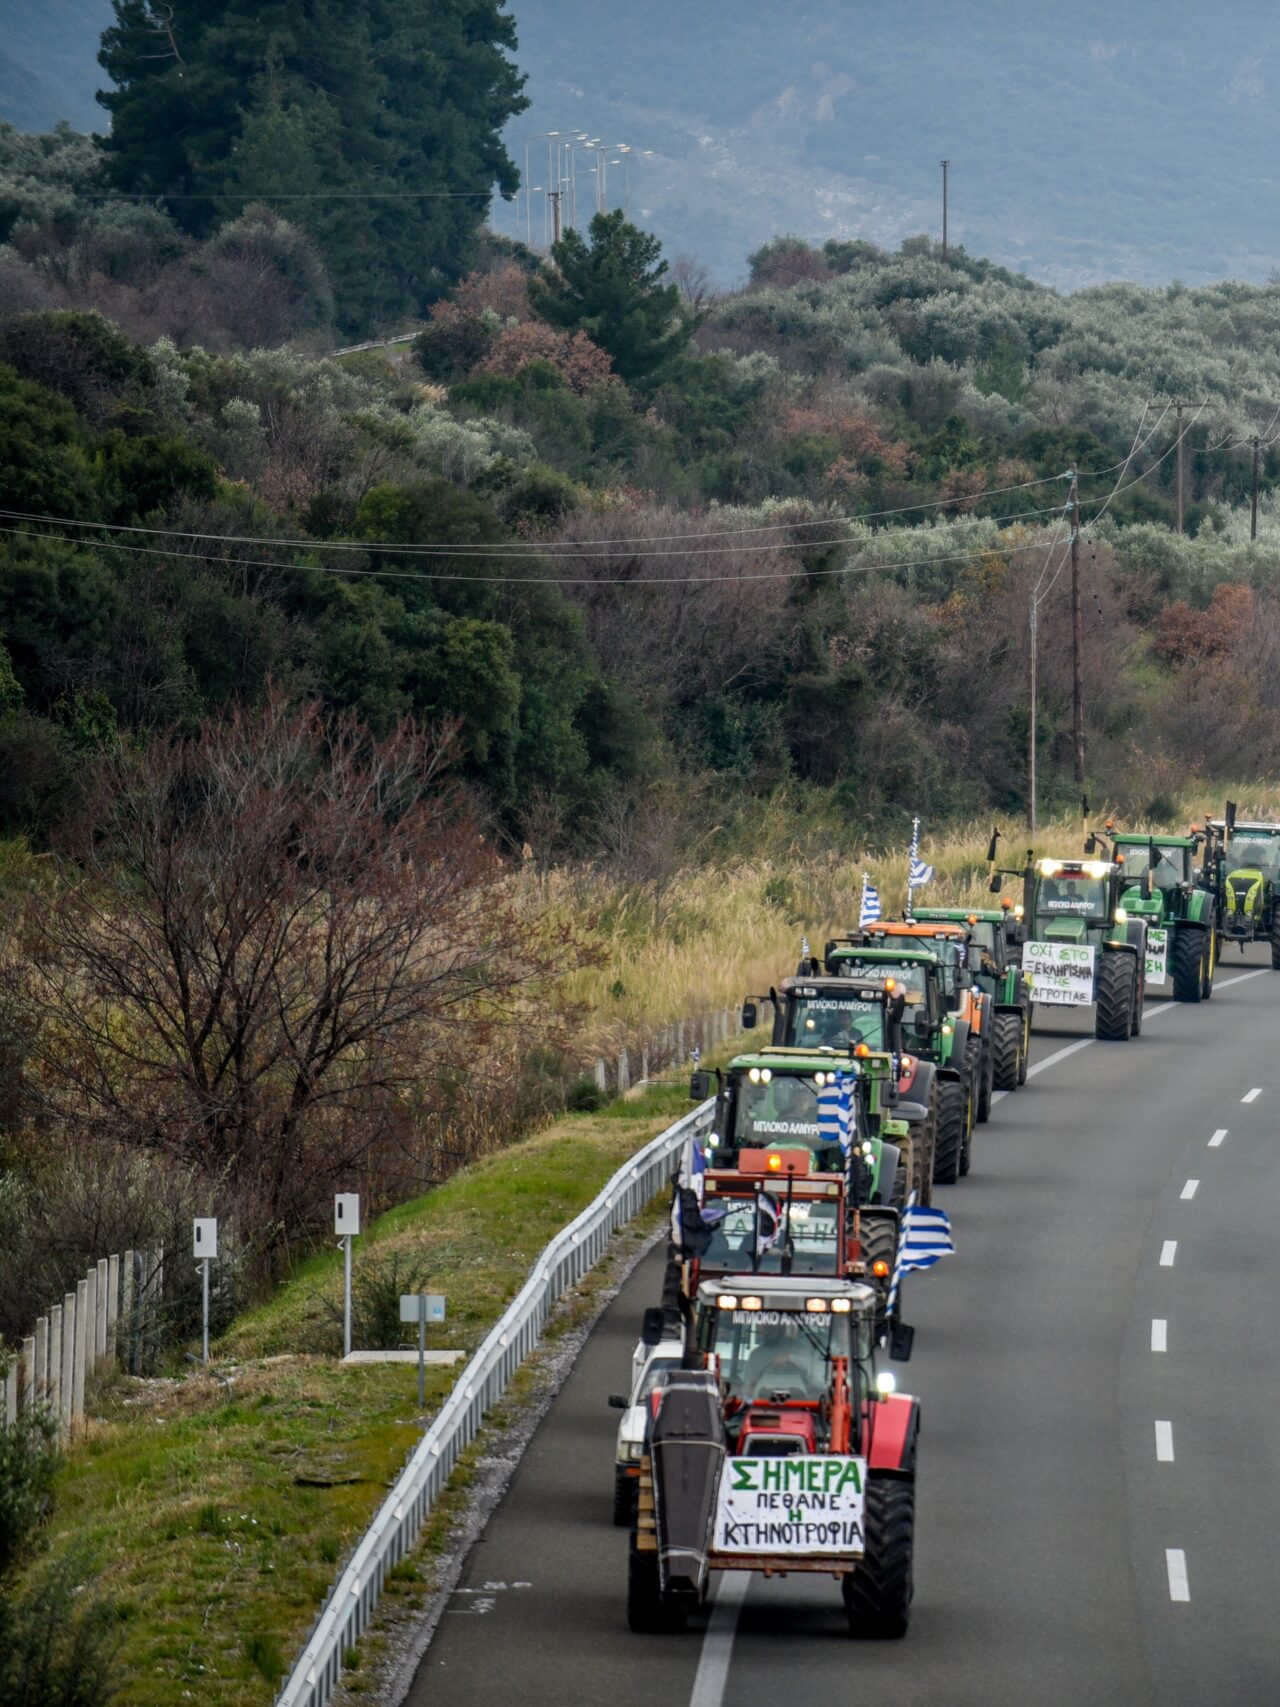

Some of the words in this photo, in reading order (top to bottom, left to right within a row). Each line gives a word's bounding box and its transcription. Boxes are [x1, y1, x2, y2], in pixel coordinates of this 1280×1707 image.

[1031, 988, 1090, 1003] ΑΓΡΟΤΙΑΣ
[807, 1000, 837, 1010] ΜΠΛΟΚΟ
[838, 1001, 873, 1012] ΑΛΜΥΡΟΥ
[753, 1120, 788, 1133] ΜΠΛΟΚΟ
[789, 1122, 818, 1135] ΑΛΜΥΡ
[732, 1310, 780, 1325] ΜΠΛΟΚΟ
[731, 1460, 862, 1494] ΣΗΜΕΡΑ
[757, 1492, 841, 1510] ΠΕΘΑΝΕ
[788, 1509, 803, 1522] Η
[723, 1520, 864, 1546] ΚΤΗΝΟΤΡΟΦΙΑ
